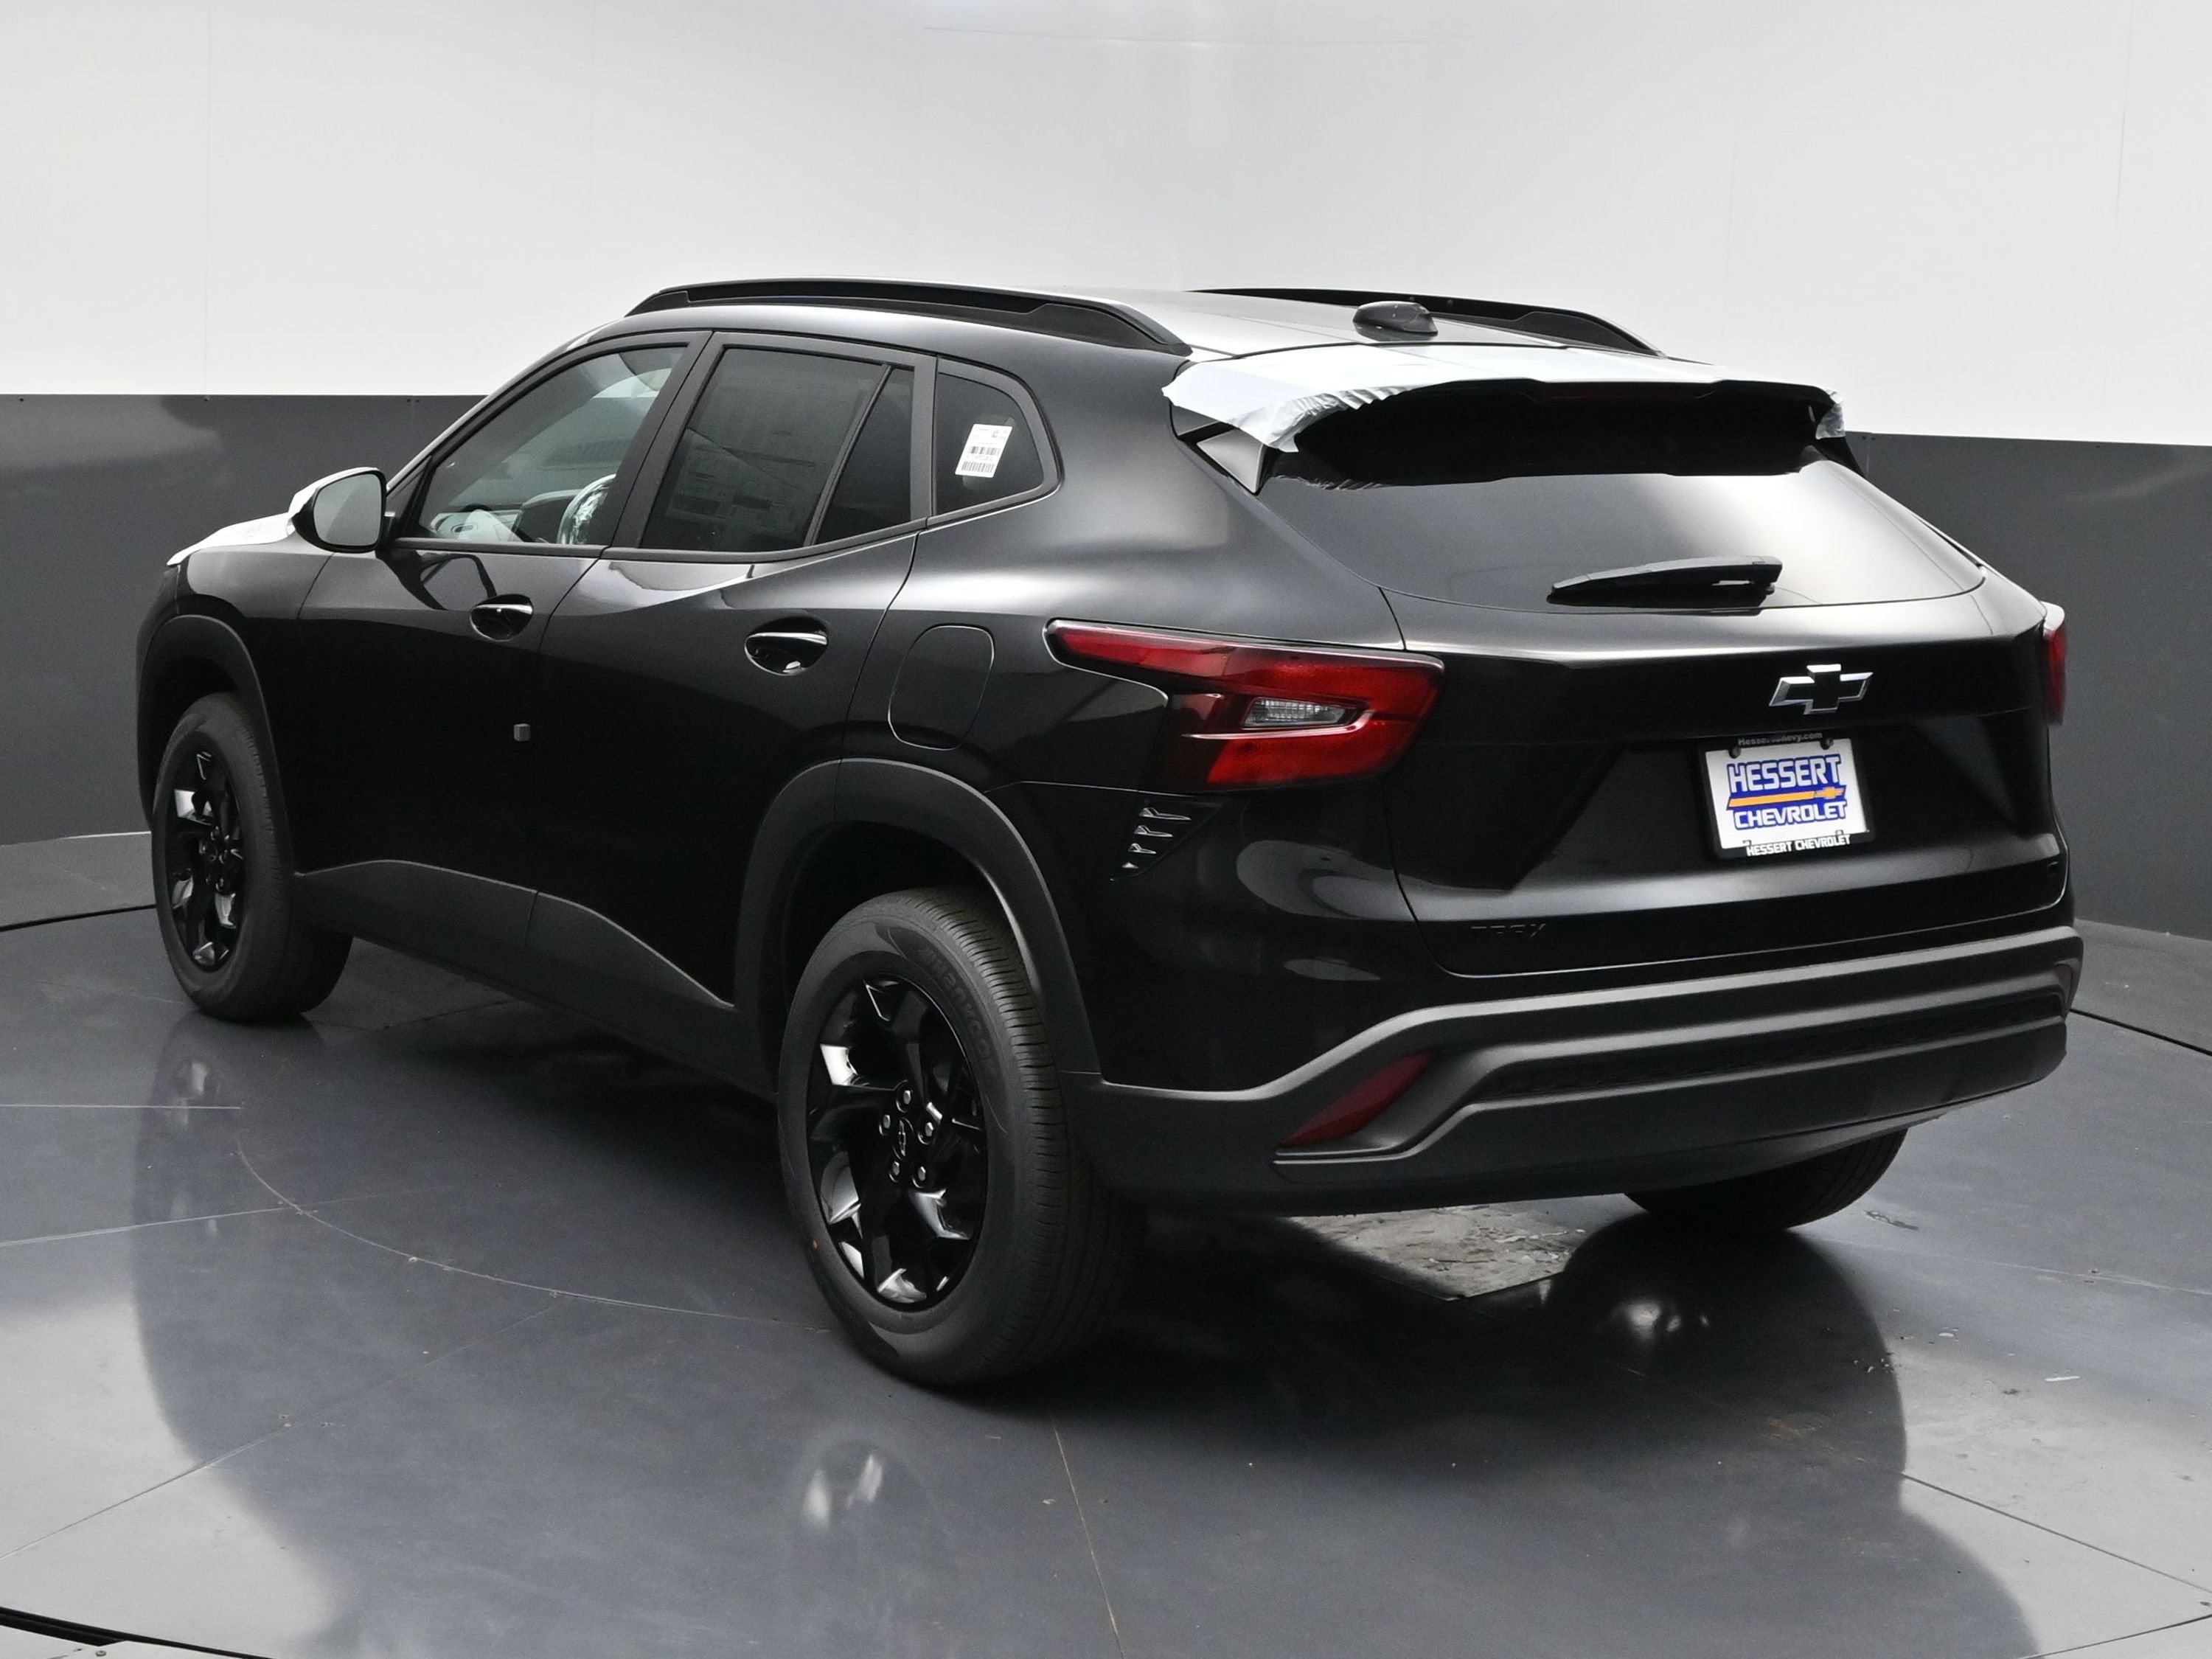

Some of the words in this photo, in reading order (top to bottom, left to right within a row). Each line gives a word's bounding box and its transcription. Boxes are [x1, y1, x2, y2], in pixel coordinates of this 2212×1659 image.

[1728, 756, 1841, 793] HESSERT
[1735, 802, 1847, 829] CHEVROLET
[1746, 841, 1792, 857] HESSERT
[1795, 834, 1851, 851] CHEVROLET
